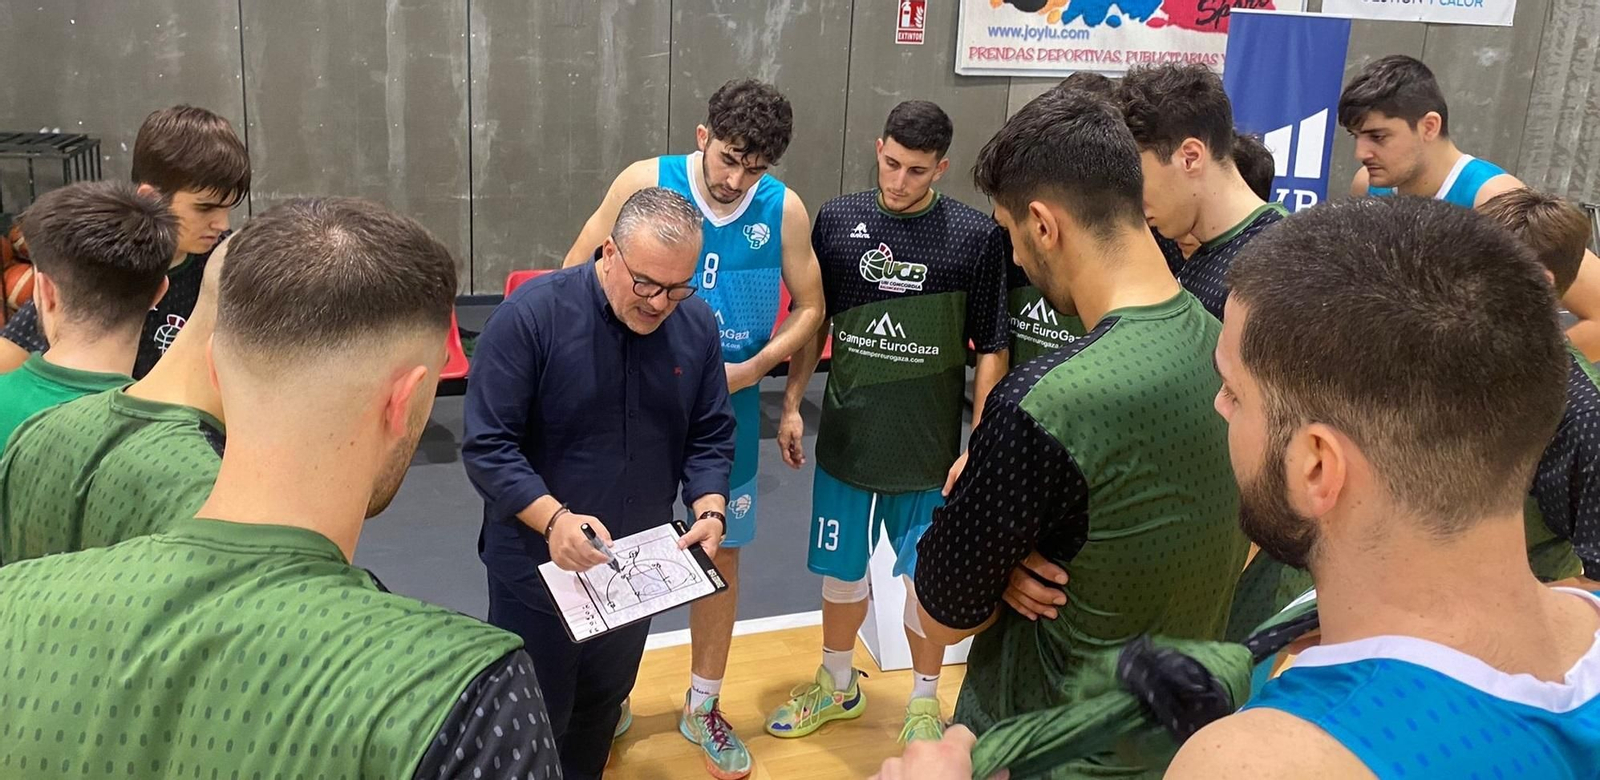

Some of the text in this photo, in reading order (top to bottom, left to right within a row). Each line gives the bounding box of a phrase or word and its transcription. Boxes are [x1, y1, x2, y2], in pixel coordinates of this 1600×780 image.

[988, 25, 1090, 41] www.joylu.com
[968, 46, 1034, 61] PRENDAS
[702, 252, 719, 289] 8
[882, 260, 928, 282] UCB
[838, 331, 939, 355] Camper EuroGaza
[817, 516, 840, 551] 13
